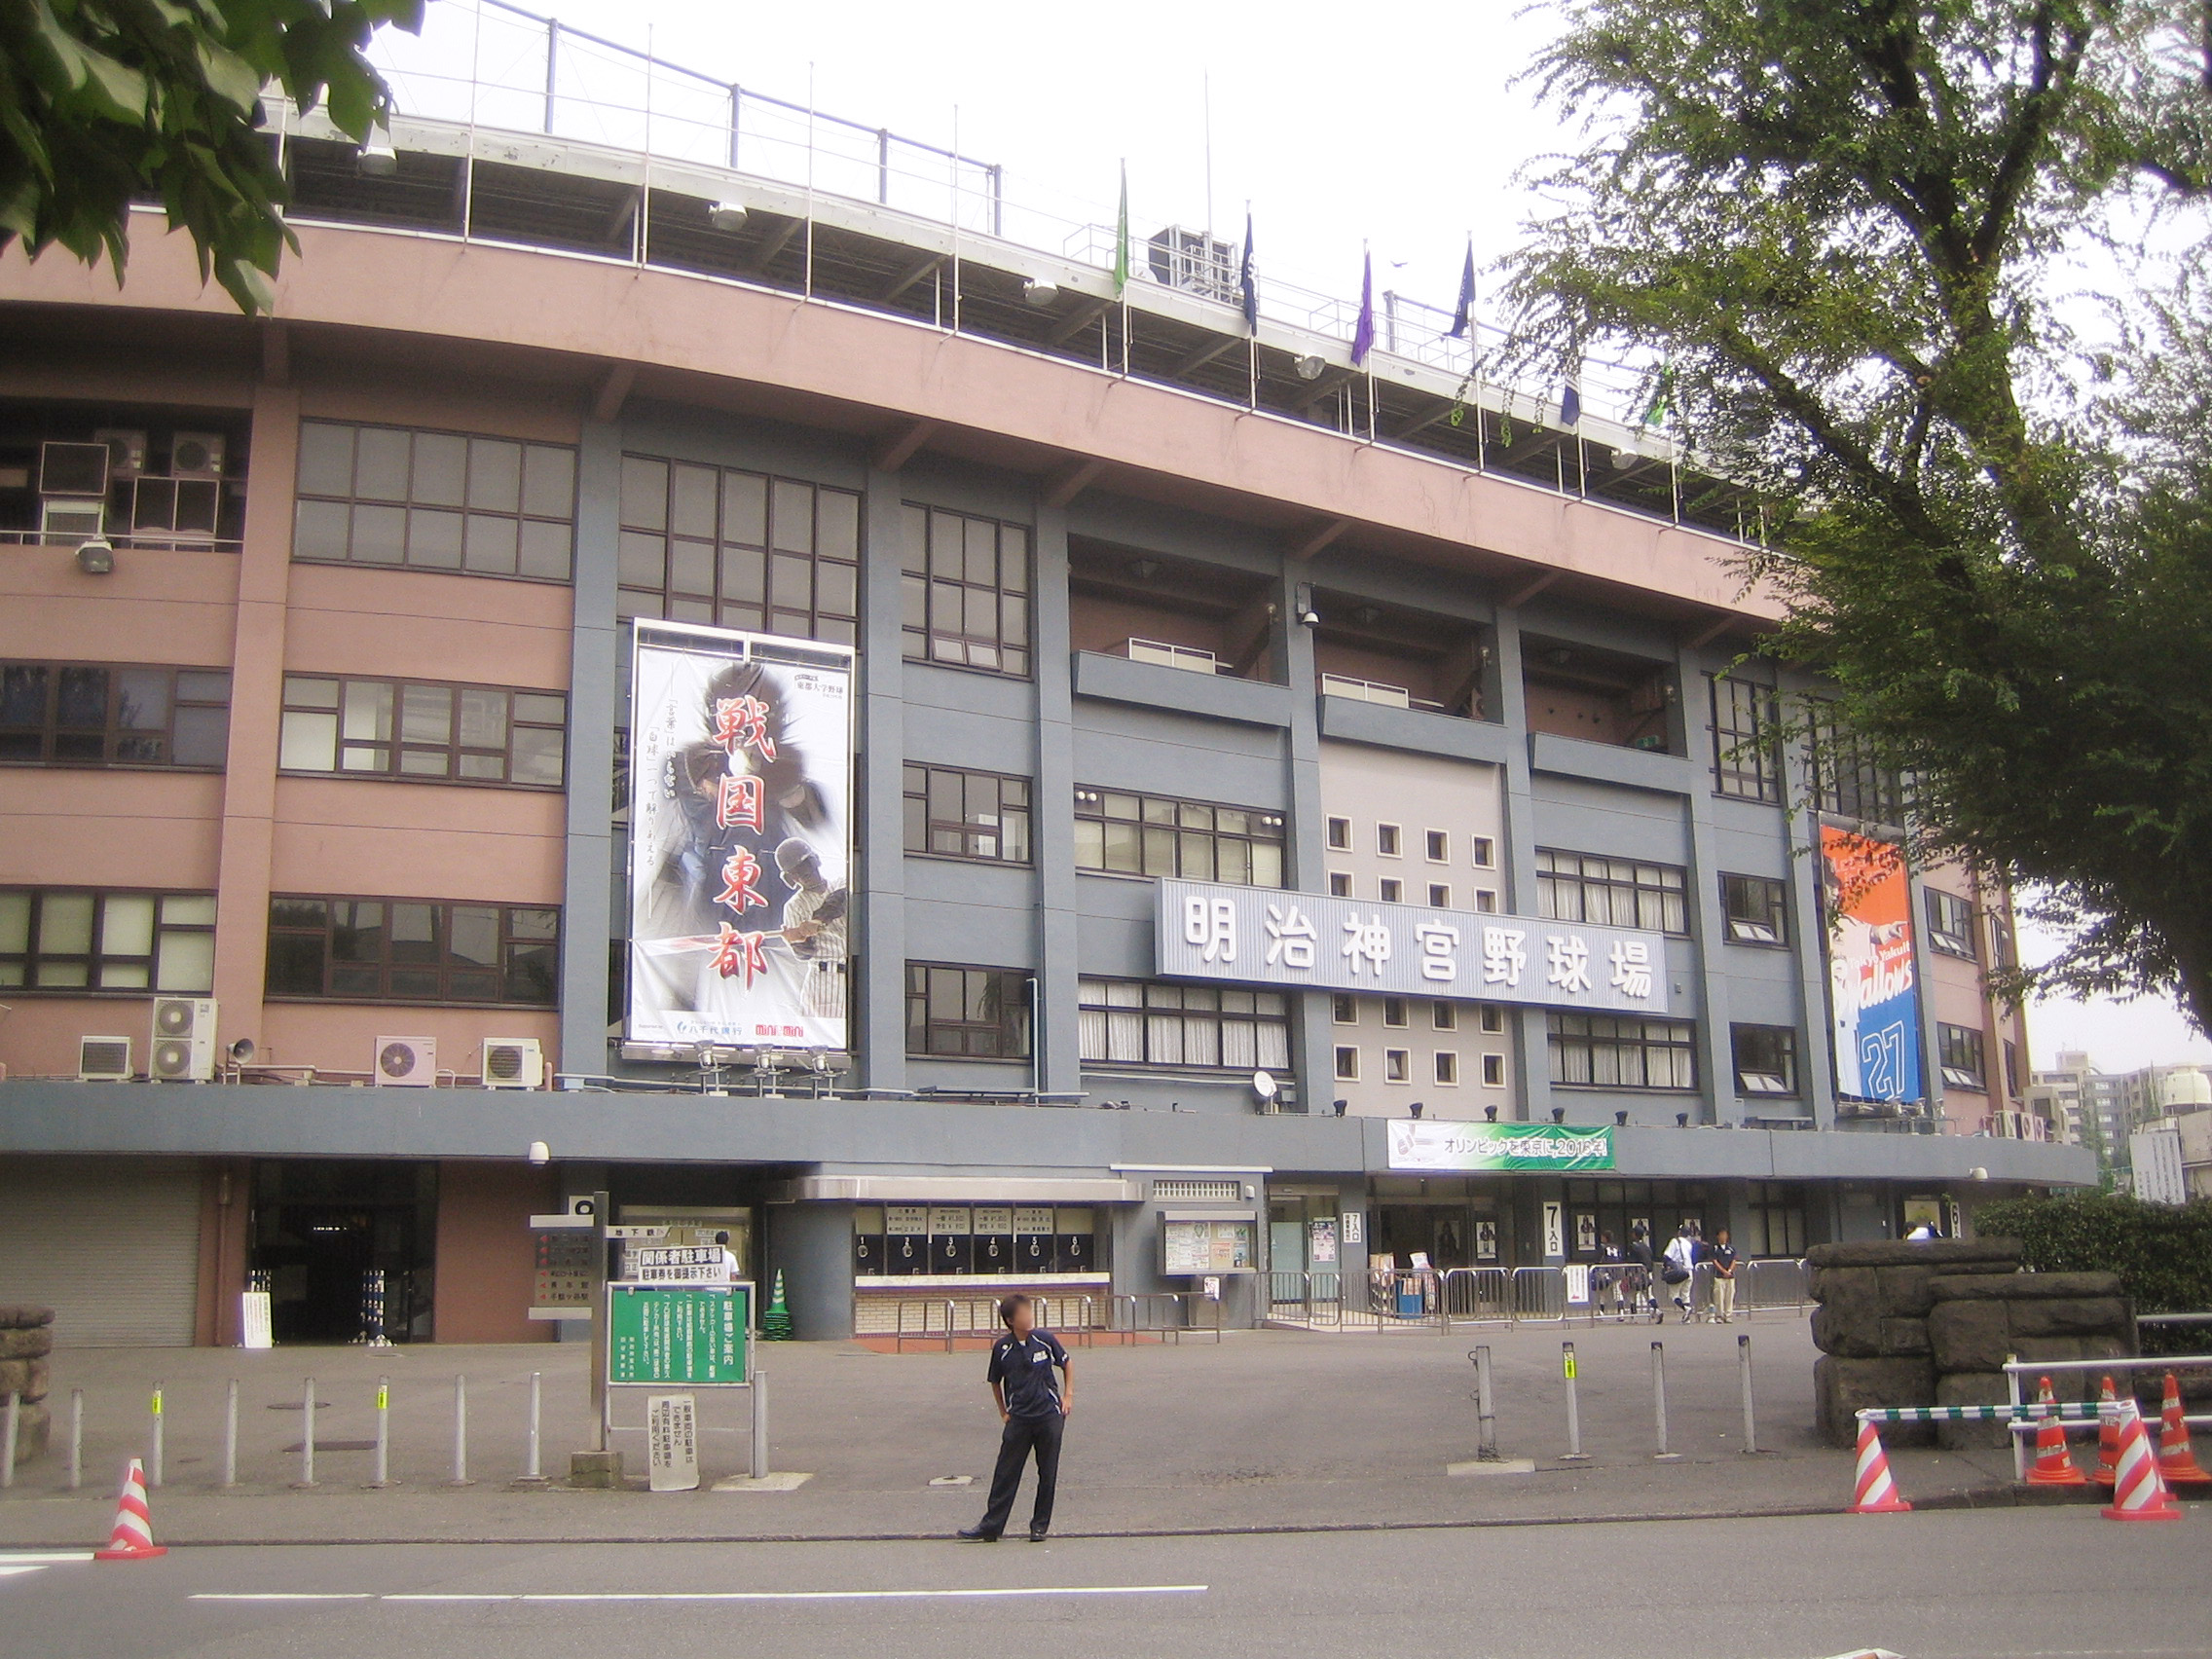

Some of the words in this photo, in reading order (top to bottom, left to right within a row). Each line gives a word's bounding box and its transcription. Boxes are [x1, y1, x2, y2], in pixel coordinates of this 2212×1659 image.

[1184, 895, 1653, 998] 明治神宮野球場
[1879, 940, 1911, 962] Yakult
[1861, 1019, 1905, 1102] 27
[614, 1228, 655, 1236] 地下鉄
[1351, 1214, 1360, 1241] 7入口
[1546, 1205, 1559, 1253] 7入口
[642, 1247, 721, 1266] 関係者駐車場
[642, 1267, 722, 1281] 駐車券を御提示下さい
